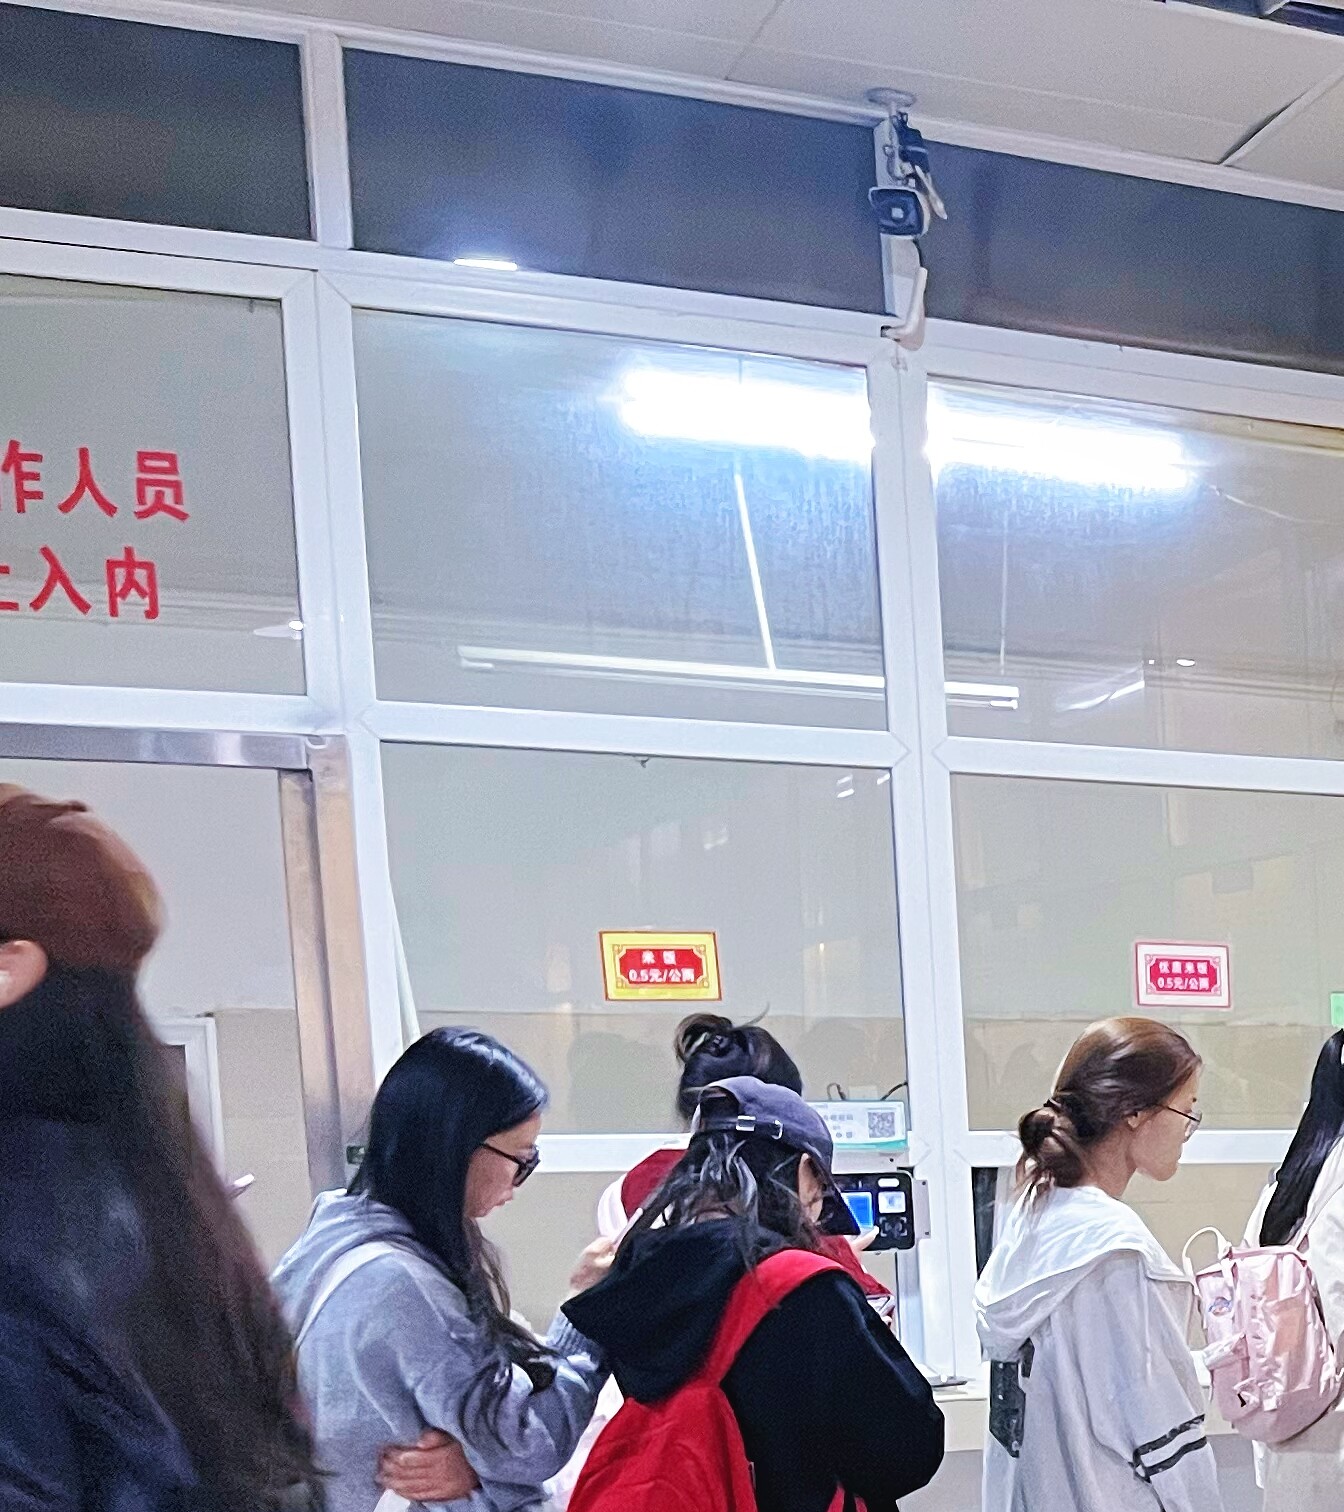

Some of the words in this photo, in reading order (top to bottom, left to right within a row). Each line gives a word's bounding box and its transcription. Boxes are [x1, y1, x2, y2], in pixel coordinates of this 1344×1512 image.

[2, 440, 190, 522] 作人员
[628, 968, 695, 983] 0.5元/公两
